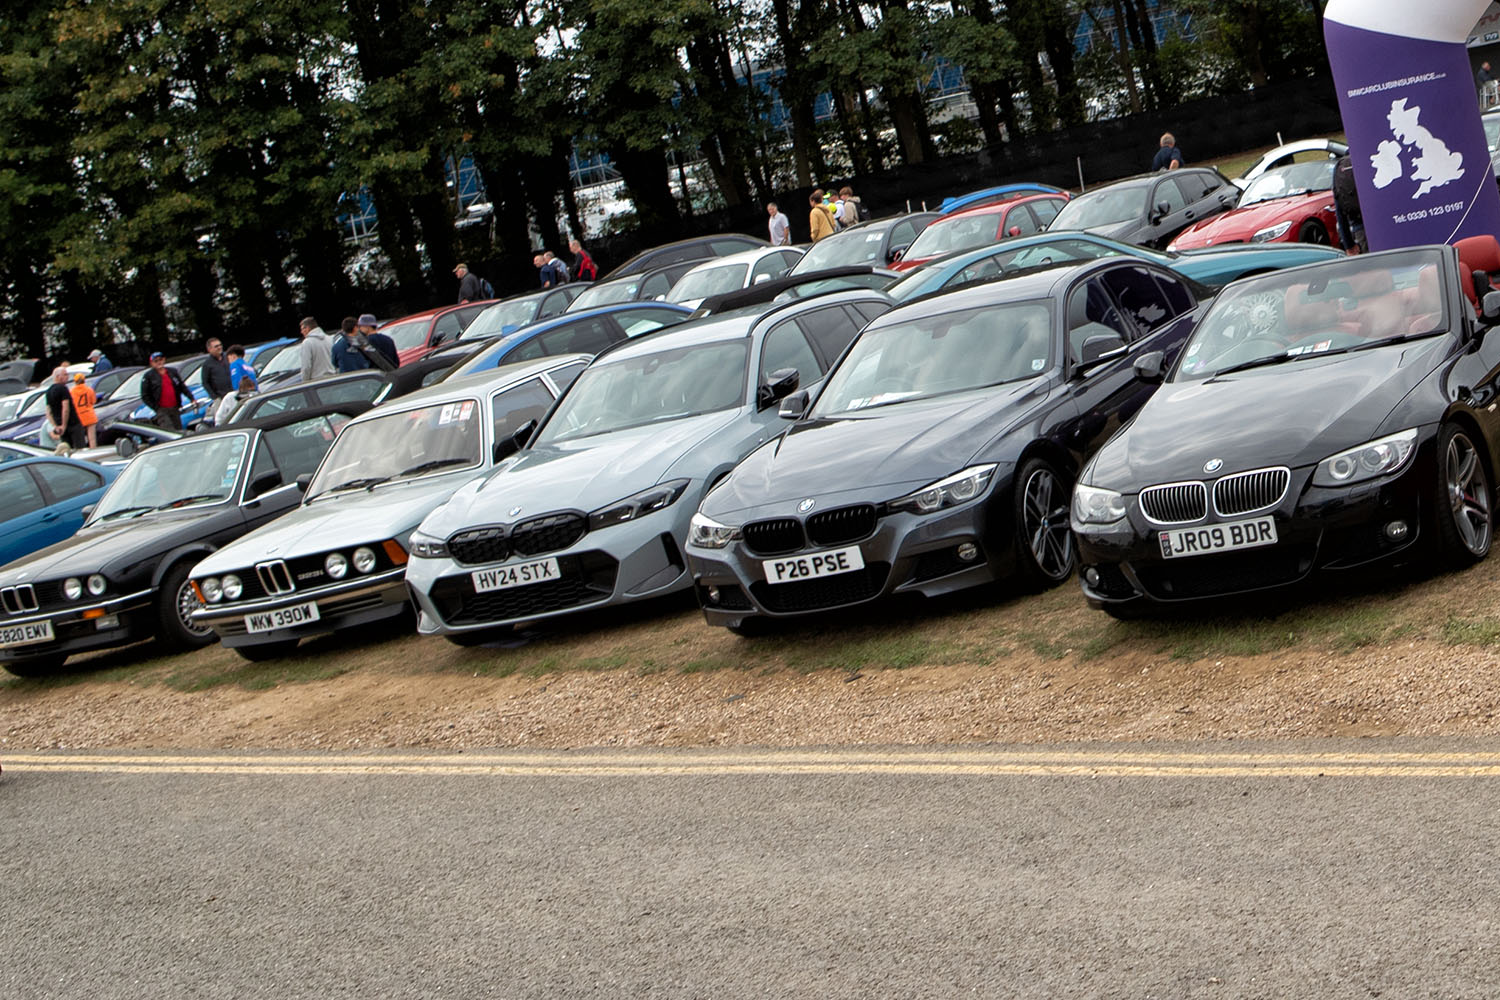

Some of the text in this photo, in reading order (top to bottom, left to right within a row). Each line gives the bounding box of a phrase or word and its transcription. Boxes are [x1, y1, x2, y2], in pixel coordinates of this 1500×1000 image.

[1347, 72, 1447, 98] BMWCARCLUBINSURANCE
[1406, 209, 1428, 222] 0330
[1428, 206, 1444, 217] 123
[1444, 201, 1464, 213] 0197
[78, 392, 89, 408] 4
[1174, 528, 1225, 553] JR09
[1229, 520, 1272, 546] BDR
[479, 561, 552, 589] HV24 STX
[775, 551, 850, 580] P26 PSE
[274, 604, 312, 626] 390W
[25, 623, 47, 640] EMV
